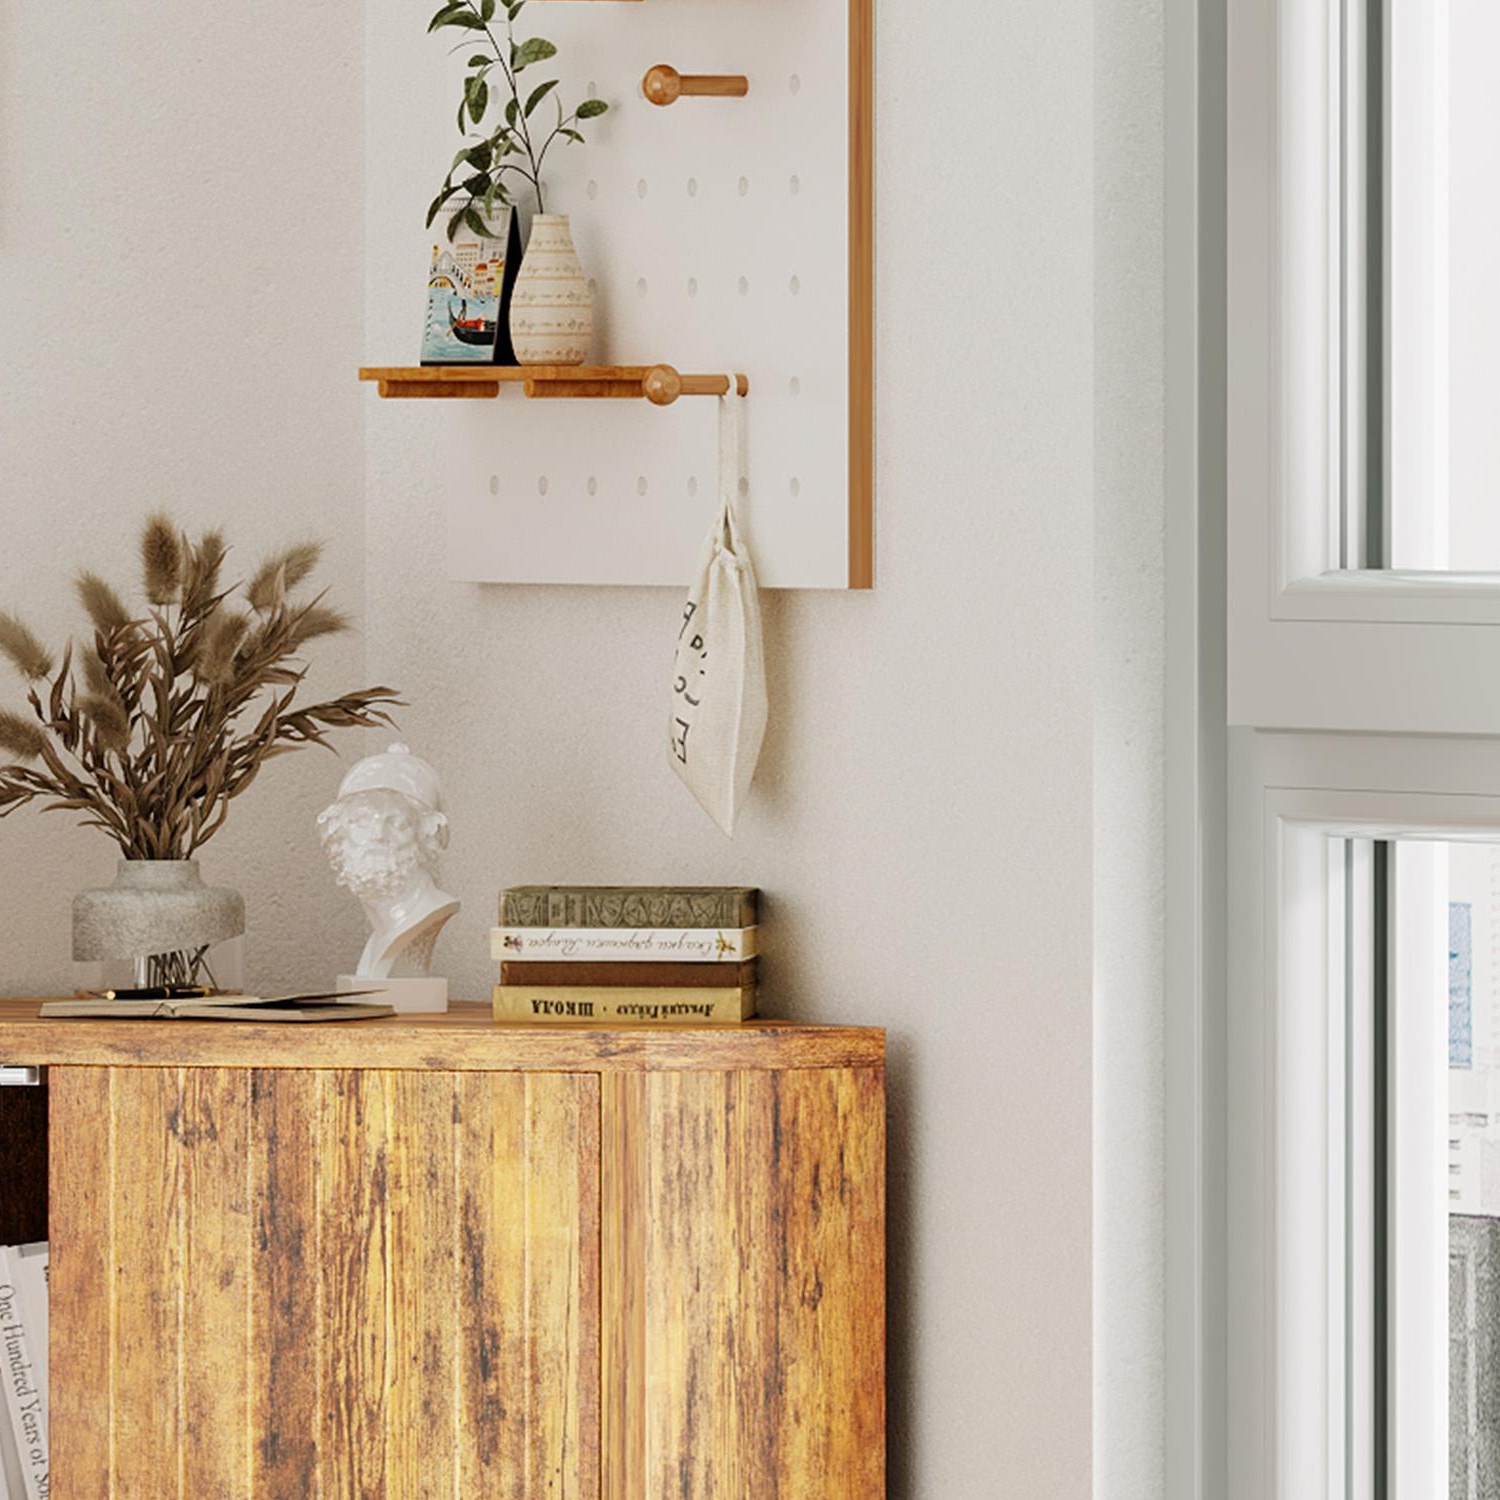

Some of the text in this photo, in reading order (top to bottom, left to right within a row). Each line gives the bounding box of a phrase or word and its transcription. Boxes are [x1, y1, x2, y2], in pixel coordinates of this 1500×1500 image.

[531, 999, 594, 1018] ШКОЛА
[3, 1324, 38, 1398] Hundred
[20, 1399, 42, 1445] Years
